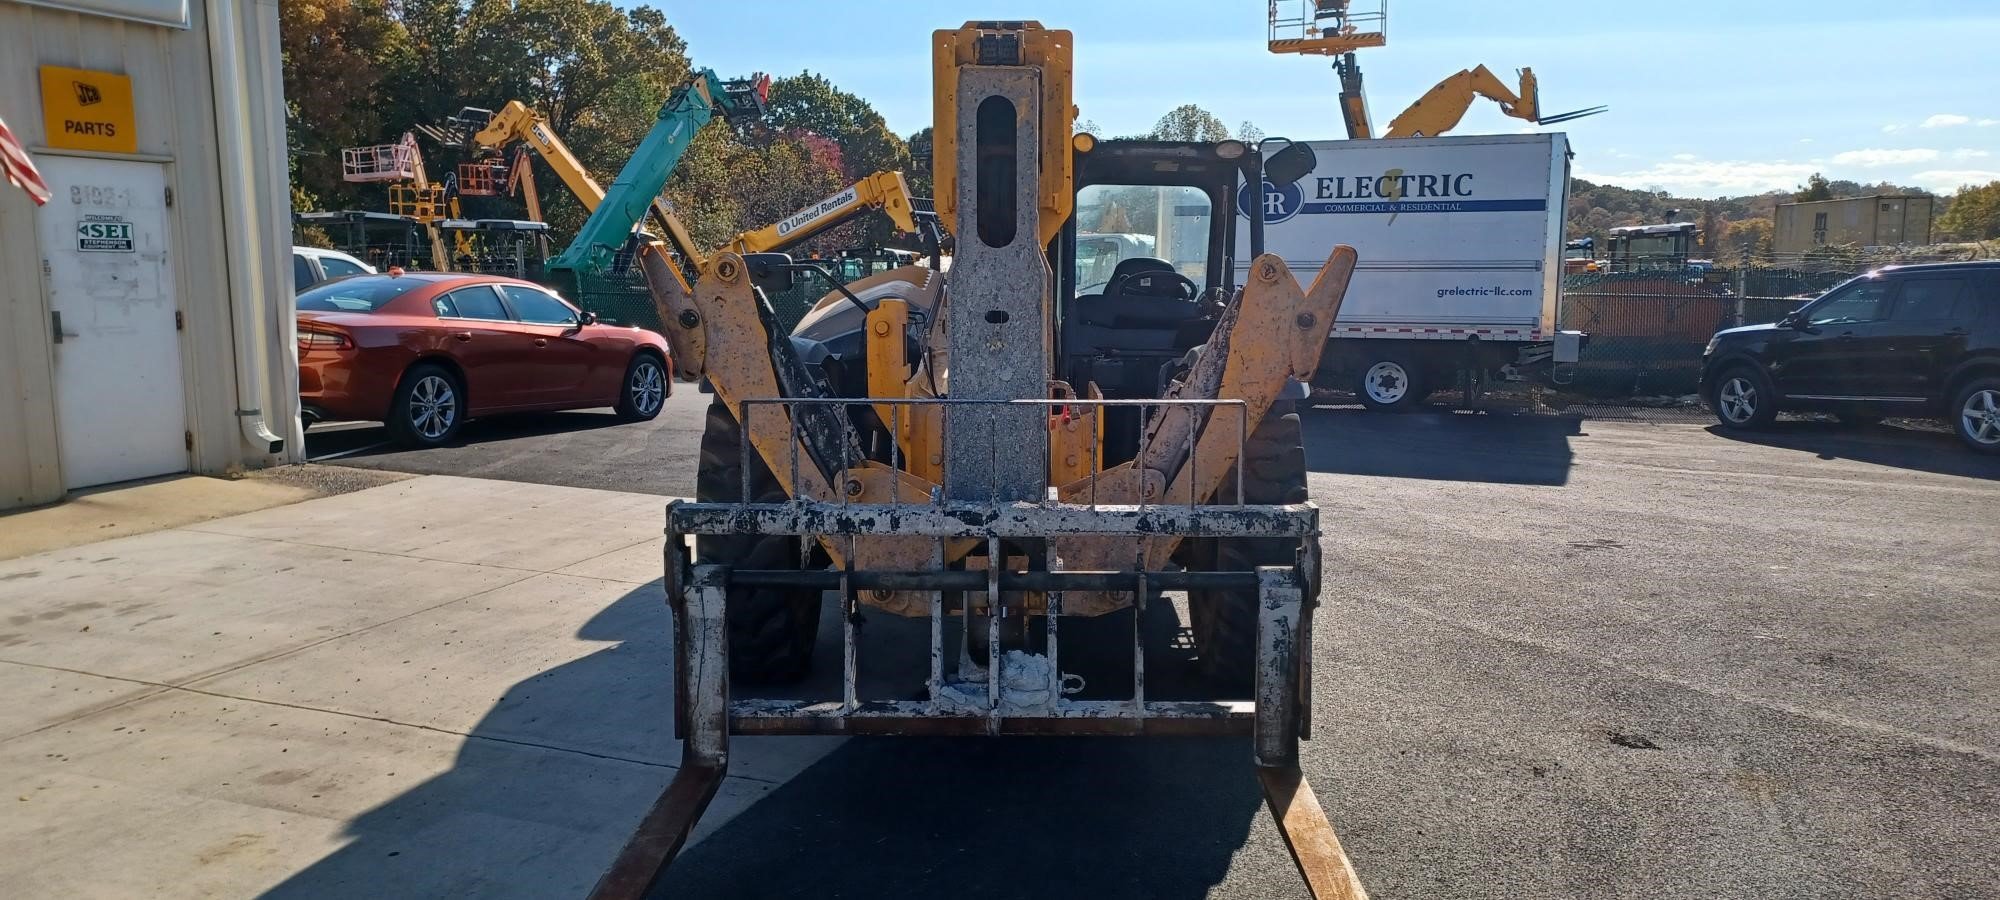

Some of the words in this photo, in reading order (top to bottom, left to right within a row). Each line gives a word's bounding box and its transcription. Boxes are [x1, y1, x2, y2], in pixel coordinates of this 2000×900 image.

[65, 120, 115, 137] PARTS
[531, 123, 549, 146] JCB
[1315, 173, 1473, 199] ELECTRIC
[791, 207, 820, 228] United
[820, 193, 853, 214] Rentals
[1324, 204, 1386, 212] COMMERCIAL
[1400, 203, 1462, 211] RESIDENTIAL
[90, 224, 129, 239] SEI
[1437, 286, 1532, 298] grelectric-llc.com
